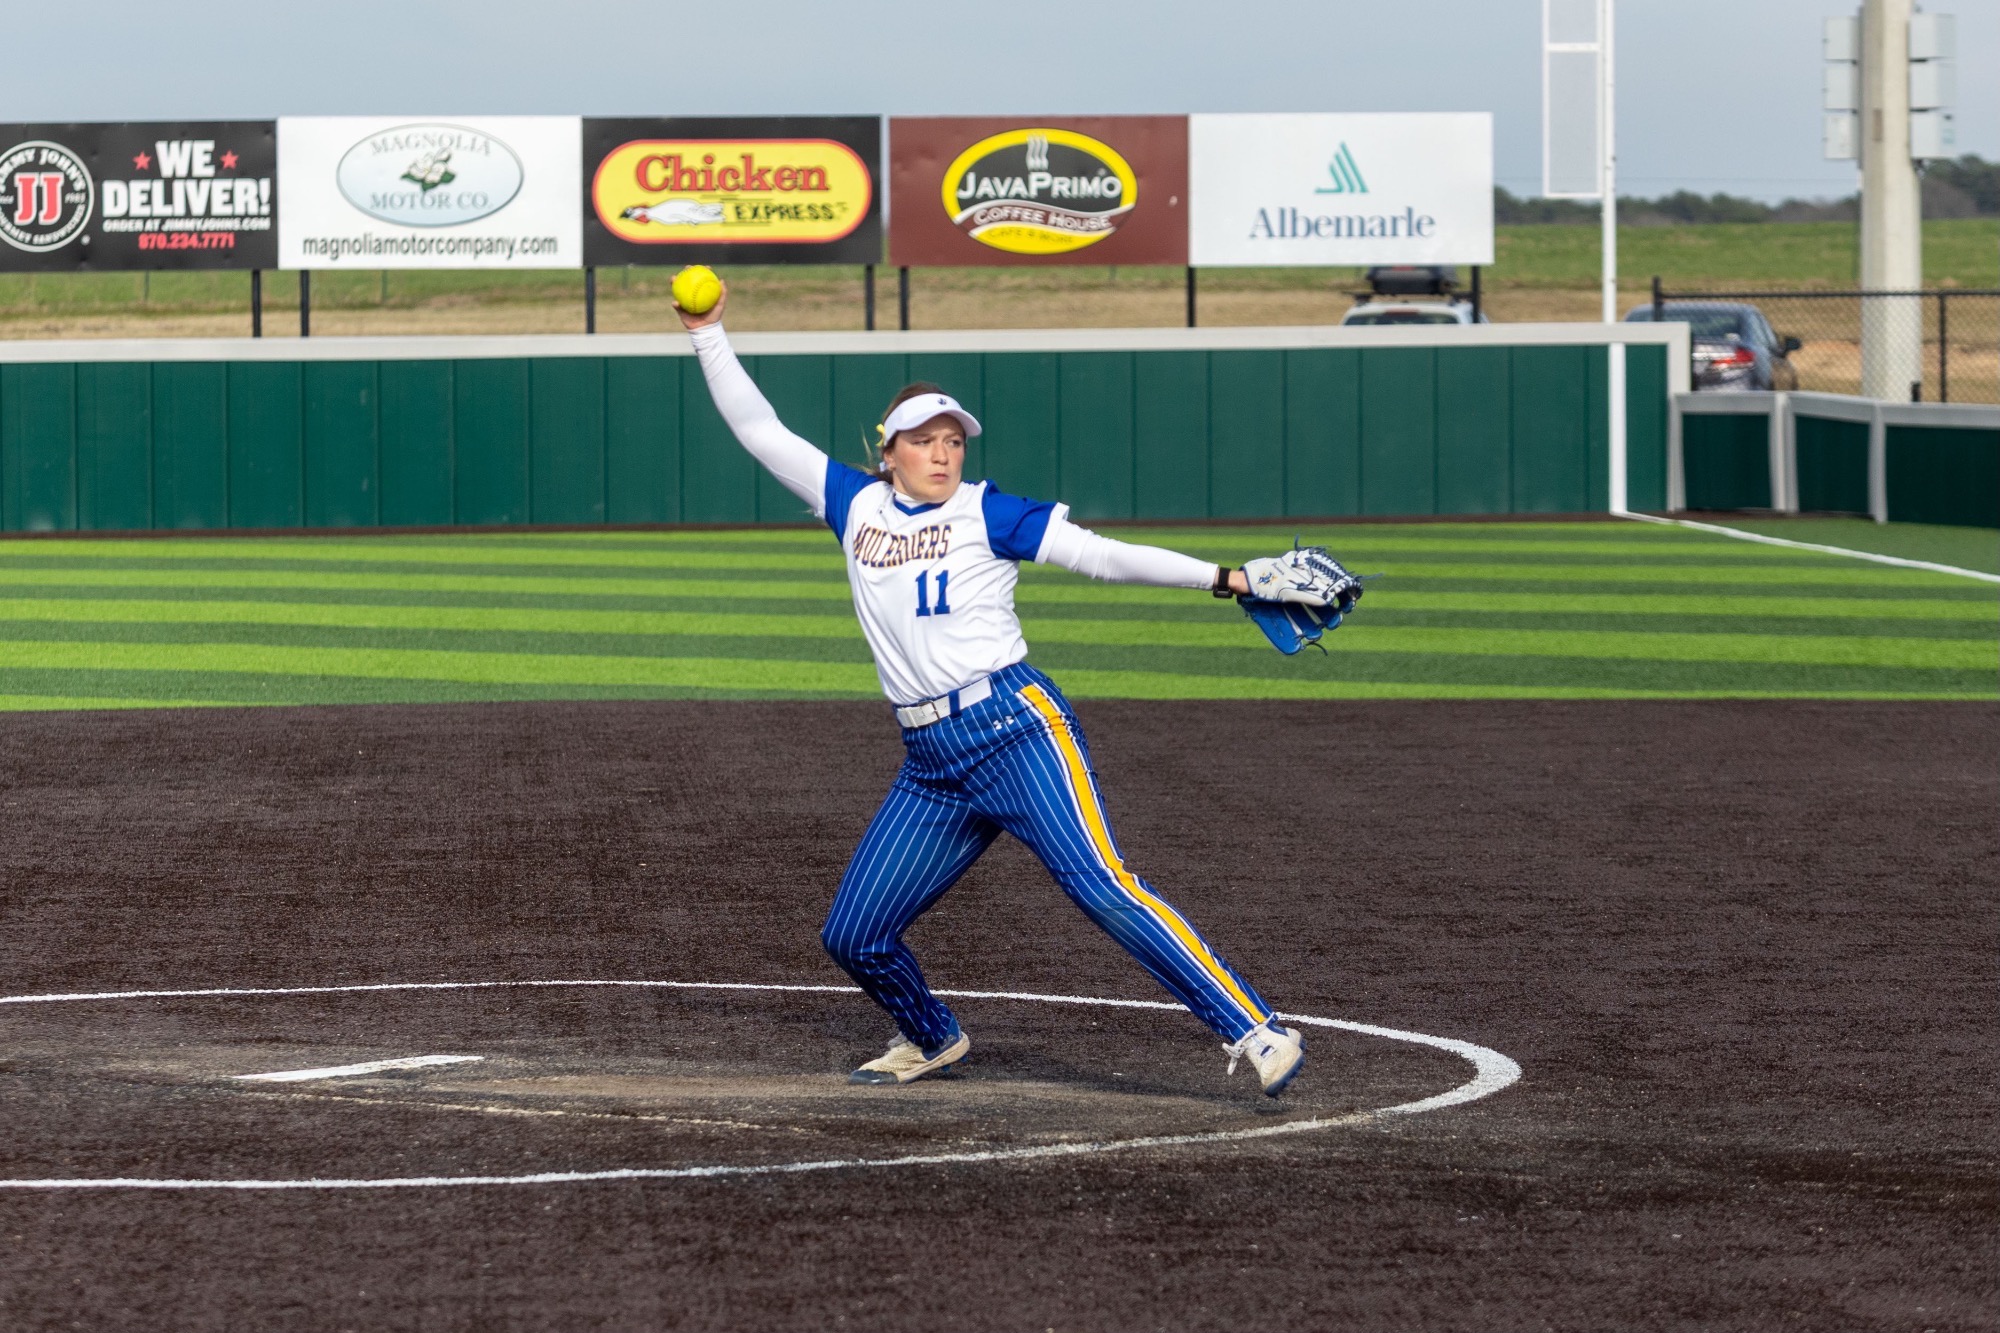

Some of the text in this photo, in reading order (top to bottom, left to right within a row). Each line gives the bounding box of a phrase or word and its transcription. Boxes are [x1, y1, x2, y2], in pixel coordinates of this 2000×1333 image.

[155, 140, 216, 178] WE
[369, 131, 492, 157] MAGNOLIA
[635, 153, 830, 192] Chicken
[14, 172, 65, 226] JJ
[102, 178, 271, 217] DELIVER!
[369, 191, 451, 211] MOTOR
[733, 202, 835, 222] EXPRESS
[102, 217, 271, 233] ORDER AT JIMMYJOHNS.COM
[973, 206, 1113, 232] COFFEE HOUSE
[1248, 206, 1436, 239] Albemarle
[303, 233, 558, 261] magnoliamotorcompany.com
[915, 569, 951, 617] 11
